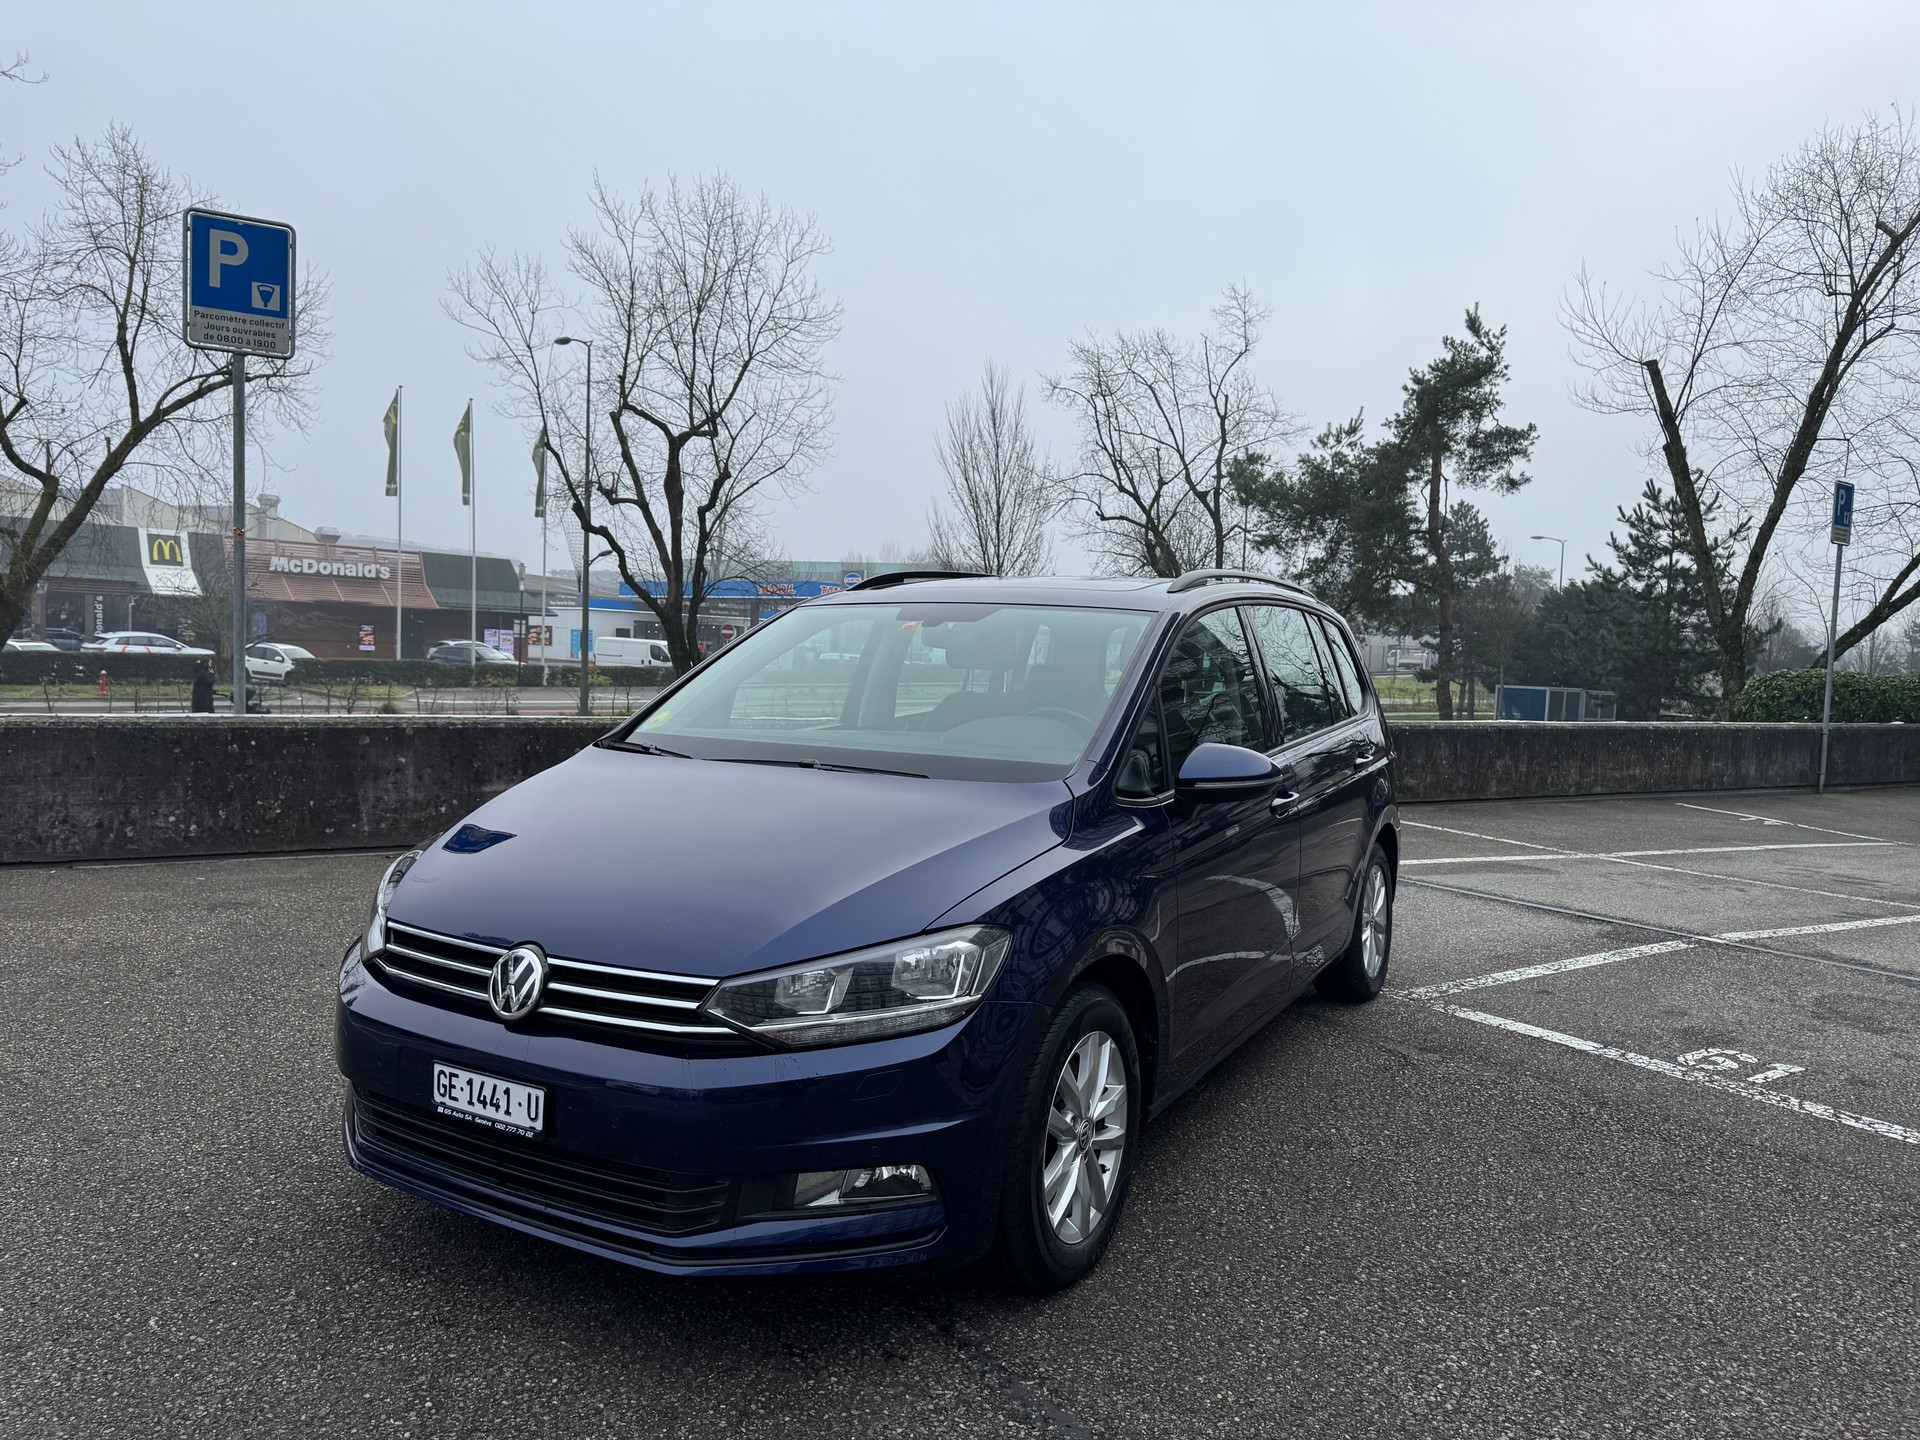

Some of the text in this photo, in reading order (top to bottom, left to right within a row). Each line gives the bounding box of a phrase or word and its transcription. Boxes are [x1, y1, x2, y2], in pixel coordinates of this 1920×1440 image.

[209, 228, 249, 289] P
[194, 310, 285, 329] Parcomètre collectif
[203, 322, 276, 338] Jours ouvrables
[203, 332, 215, 341] de
[245, 338, 251, 346] à
[1837, 488, 1846, 516] P
[268, 555, 391, 580] McDonald's
